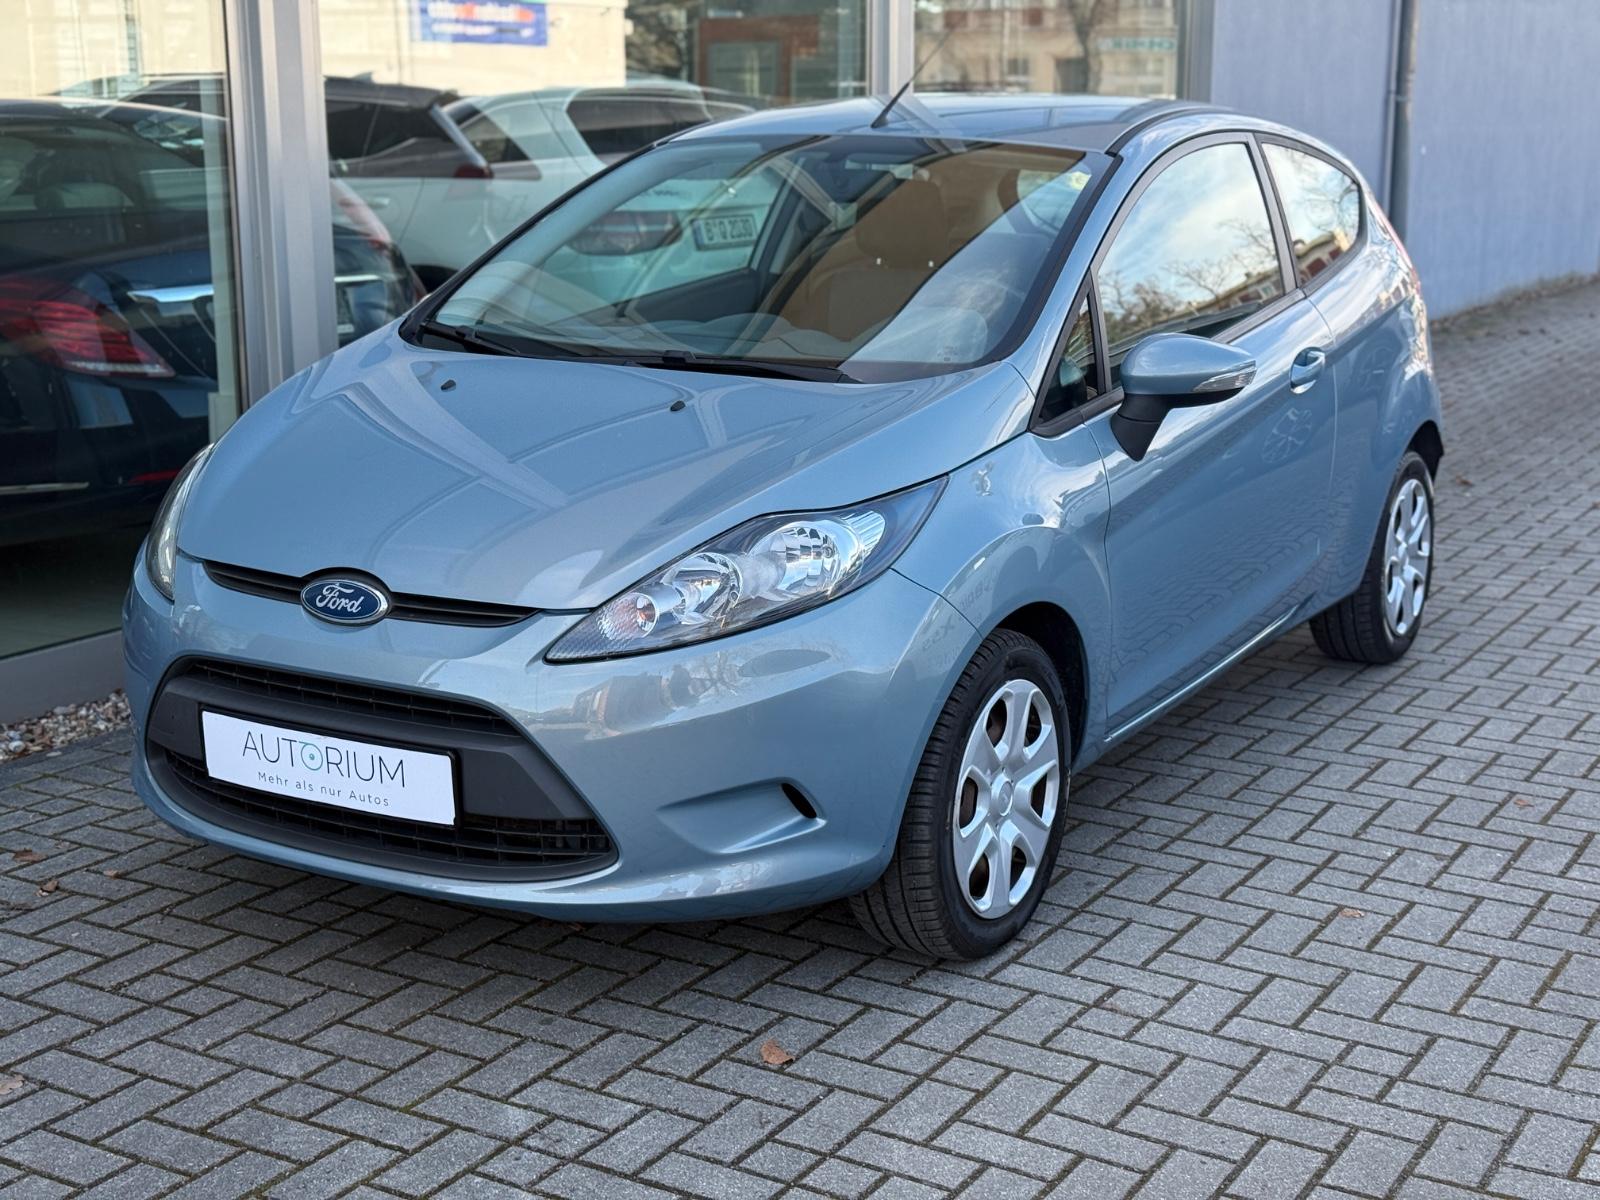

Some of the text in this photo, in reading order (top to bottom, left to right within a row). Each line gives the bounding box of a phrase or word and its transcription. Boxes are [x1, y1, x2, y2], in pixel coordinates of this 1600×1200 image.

[315, 583, 364, 613] Ford
[242, 731, 405, 788] AUTORIUM
[258, 771, 390, 807] Mehr als nur Autos
